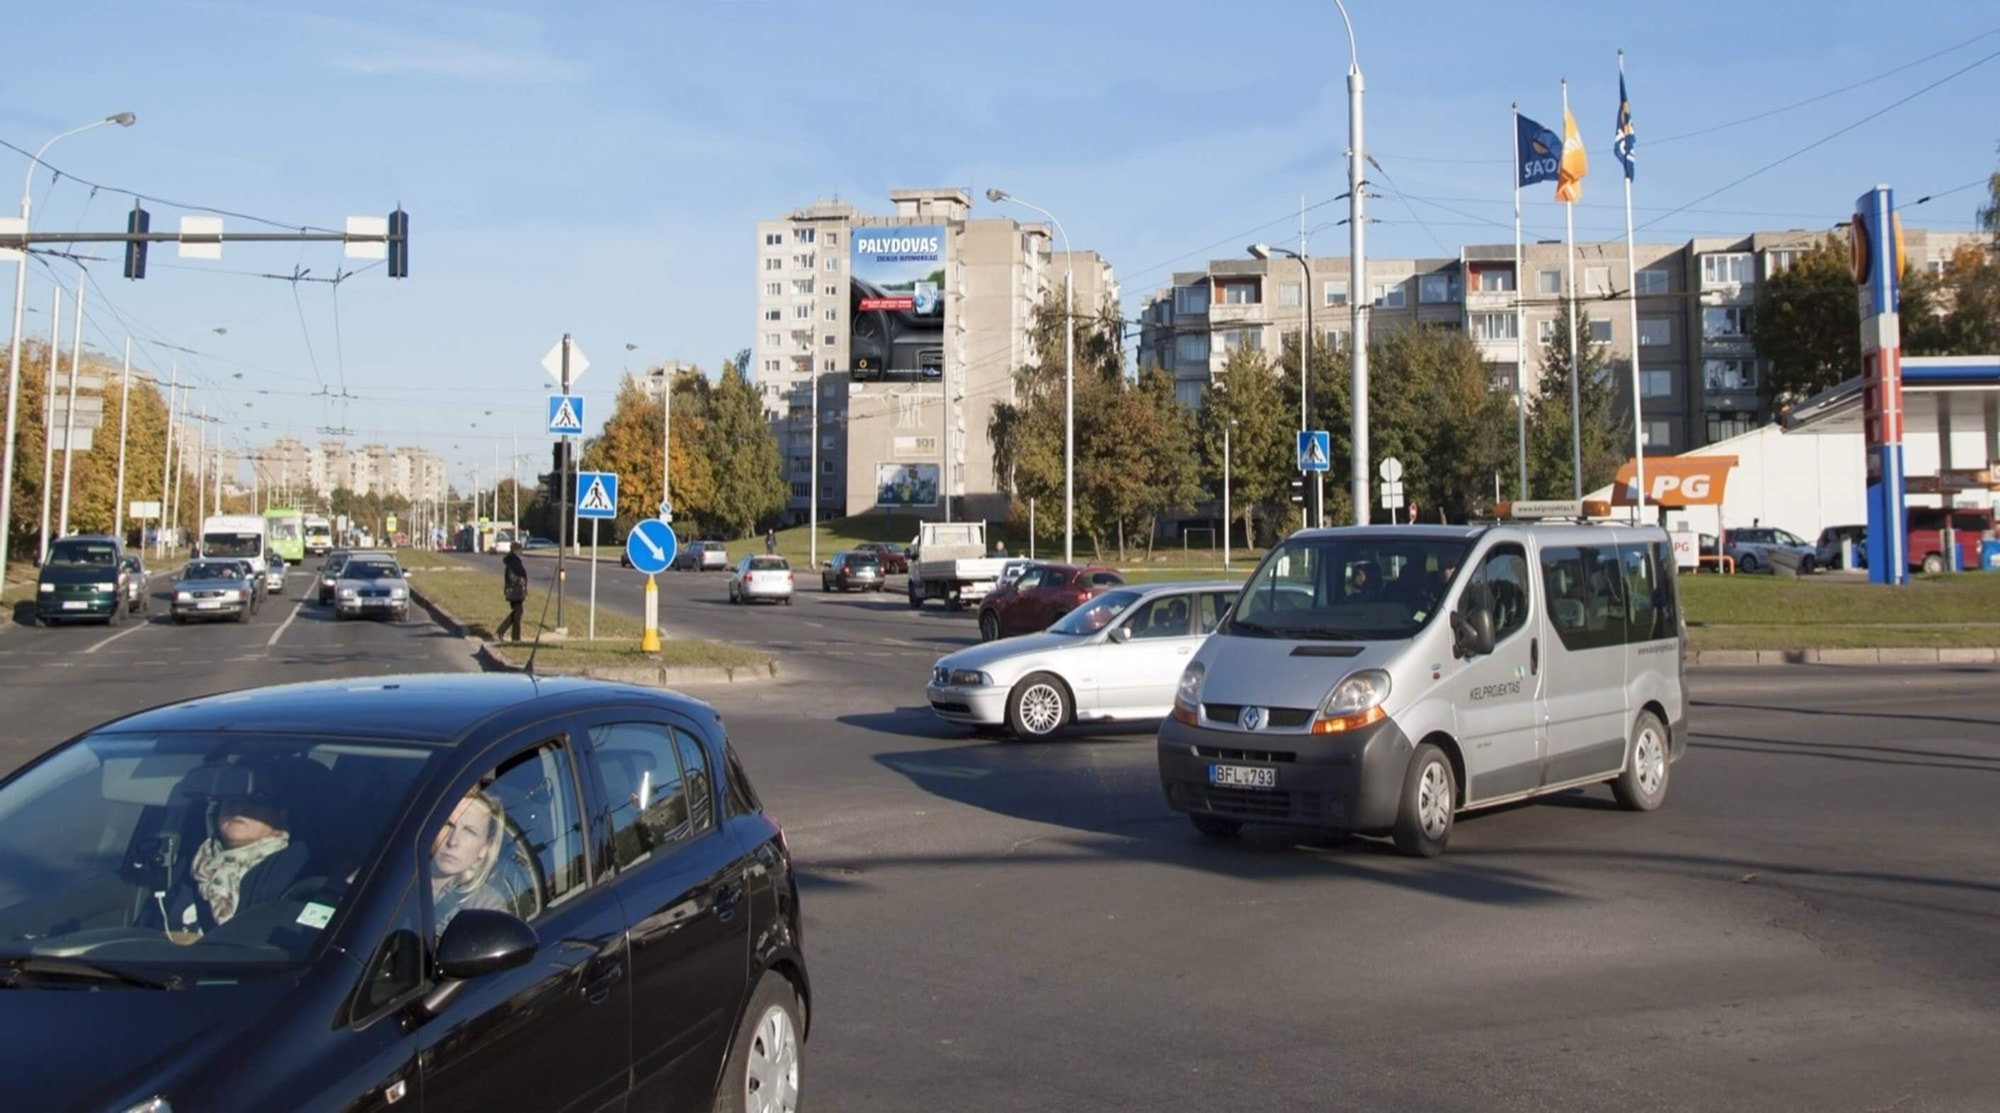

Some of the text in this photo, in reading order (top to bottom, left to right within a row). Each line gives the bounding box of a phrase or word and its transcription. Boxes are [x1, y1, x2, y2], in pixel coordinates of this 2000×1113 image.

[858, 237, 938, 254] PALYDOVAS
[1674, 541, 1689, 552] PG
[1469, 680, 1521, 701] KELPROJEKTAS
[1217, 767, 1273, 785] BFL 793
